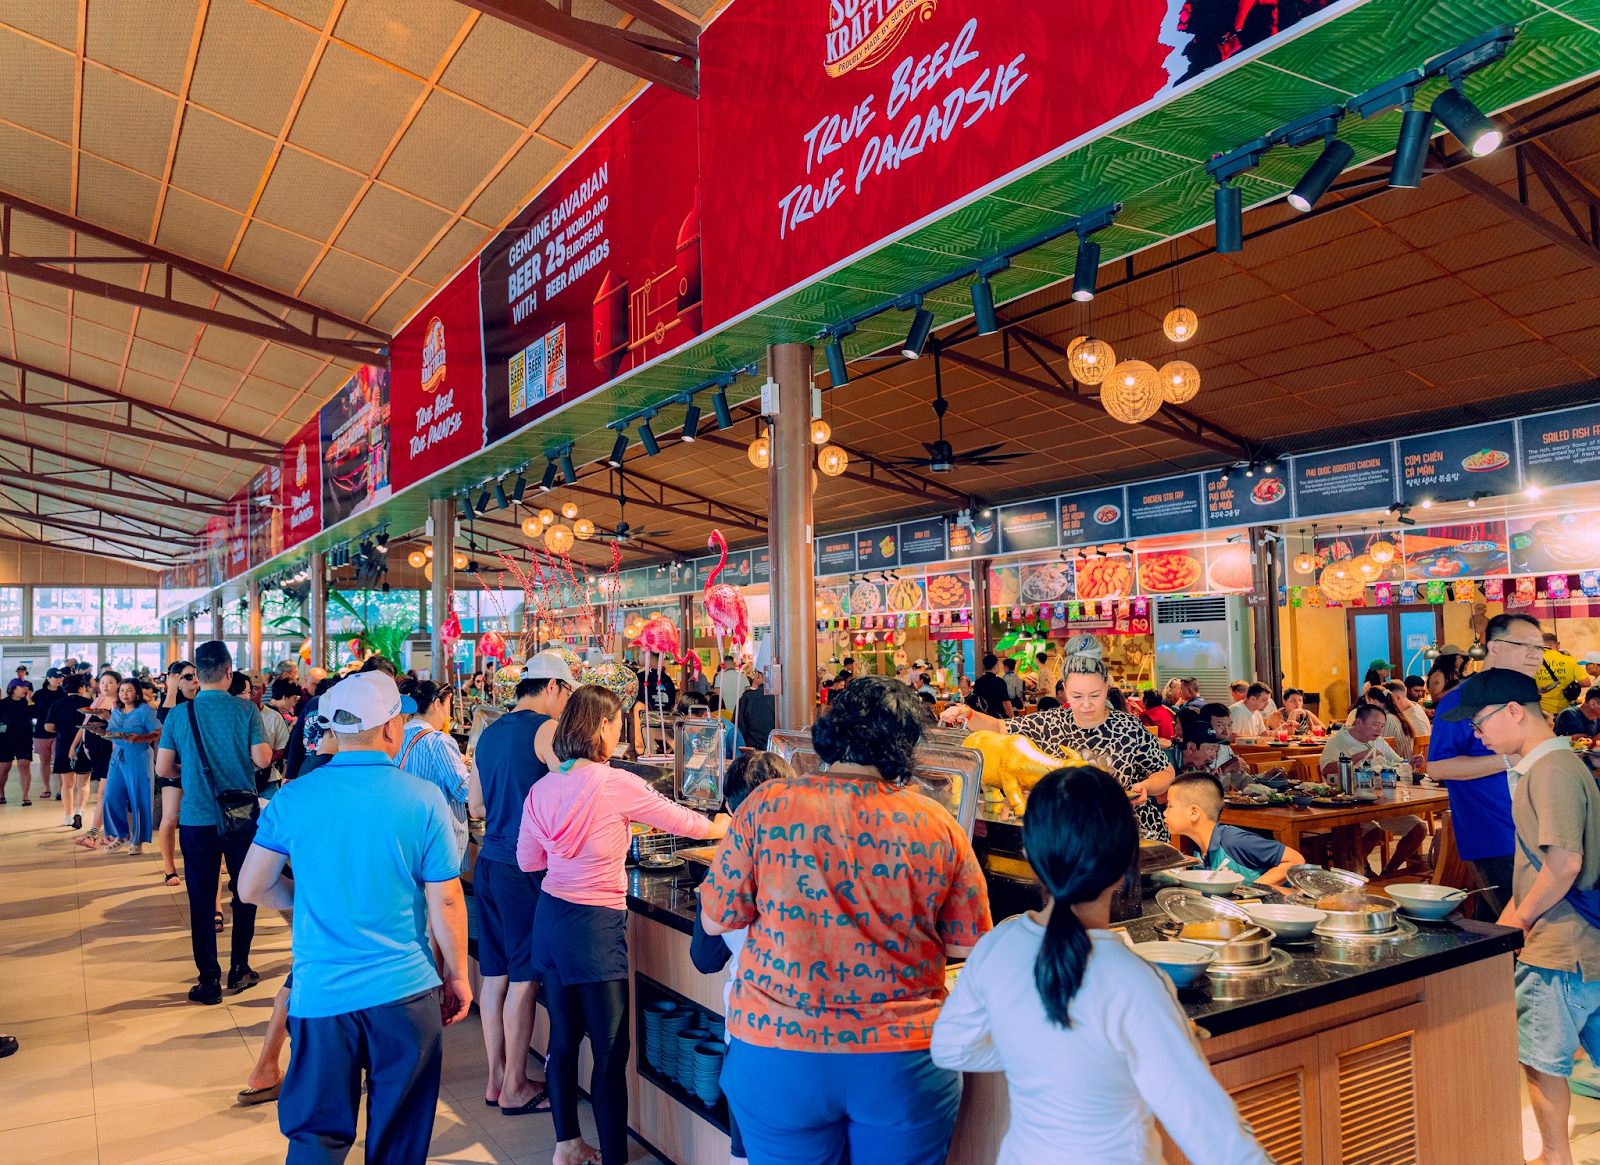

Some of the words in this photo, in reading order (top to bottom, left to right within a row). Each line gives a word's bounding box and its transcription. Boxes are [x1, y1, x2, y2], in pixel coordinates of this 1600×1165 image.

[838, 49, 863, 72] PROUDLY
[864, 32, 882, 54] MADE
[881, 23, 890, 35] BY
[891, 6, 904, 24] SUN
[804, 94, 876, 174] TRUE
[887, 17, 979, 120] BEER
[778, 168, 846, 240] TRUE
[855, 52, 1028, 194] PARADSIE
[508, 214, 550, 267] GENUINE
[551, 162, 608, 231] BAVARIAN
[566, 209, 592, 240] WORLD
[592, 194, 609, 220] AND
[566, 219, 604, 261] EUROPEAN
[508, 253, 542, 304] BEER
[545, 231, 566, 277] 25
[545, 271, 567, 301] BEER
[567, 238, 610, 286] AWARDS
[512, 290, 537, 325] WITH
[528, 355, 542, 375] BEER
[547, 343, 564, 364] BEER
[511, 367, 524, 385] BEER
[416, 405, 433, 432] TRUE
[434, 388, 454, 420] BEER
[410, 434, 426, 460] TRUE
[1572, 426, 1590, 439] FISH
[1332, 462, 1356, 473] ROASTED
[1357, 458, 1380, 470] CHICKEN
[1248, 595, 1258, 604] WC
